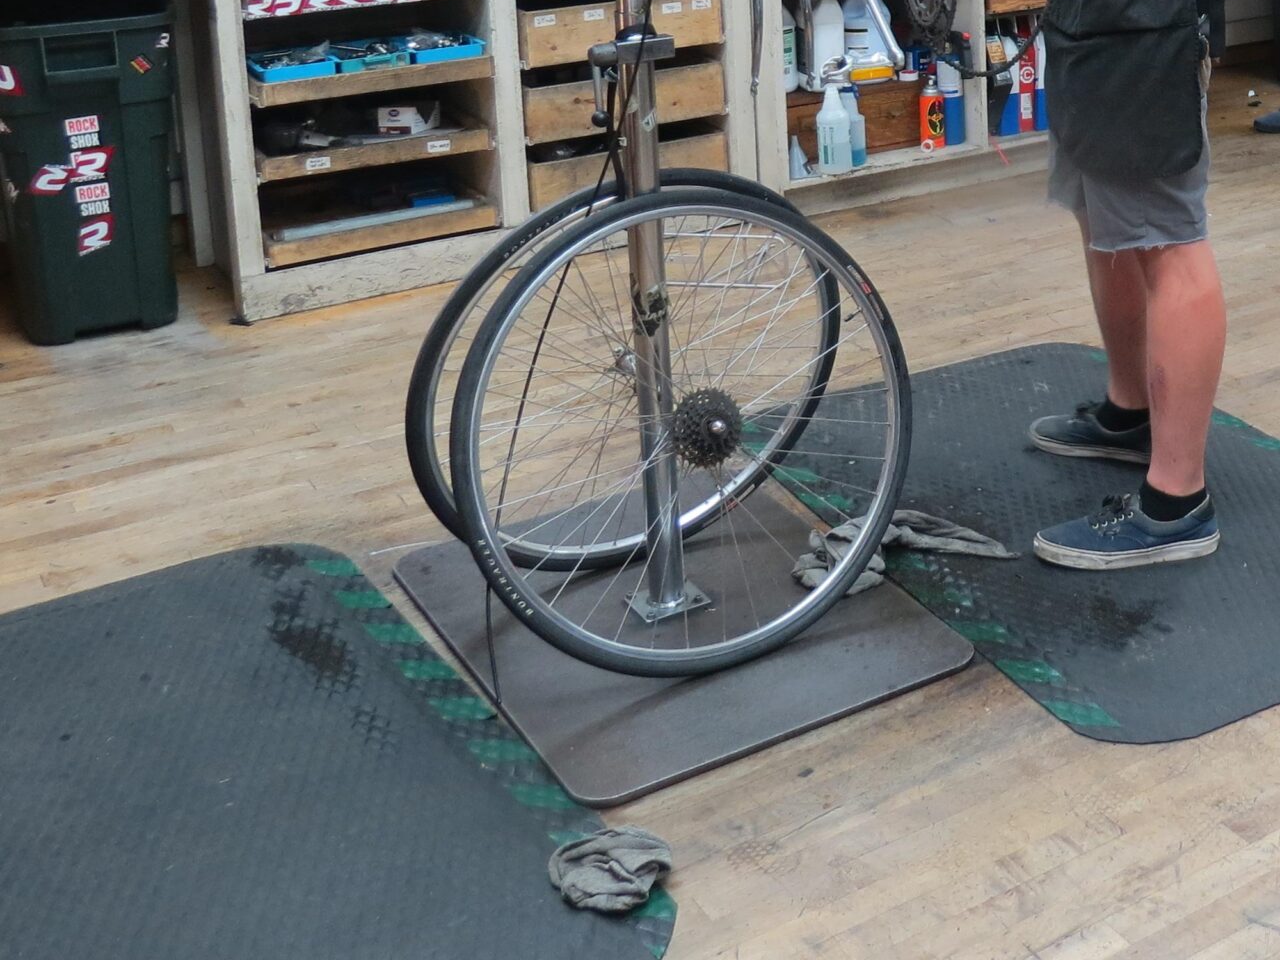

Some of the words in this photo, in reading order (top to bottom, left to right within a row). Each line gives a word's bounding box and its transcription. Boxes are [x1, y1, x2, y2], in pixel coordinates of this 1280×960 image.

[68, 117, 98, 134] ROCK
[70, 133, 101, 149] SHOX
[78, 184, 108, 201] ROCK
[80, 200, 110, 216] SHOX
[477, 538, 535, 617] BONTRAGER
